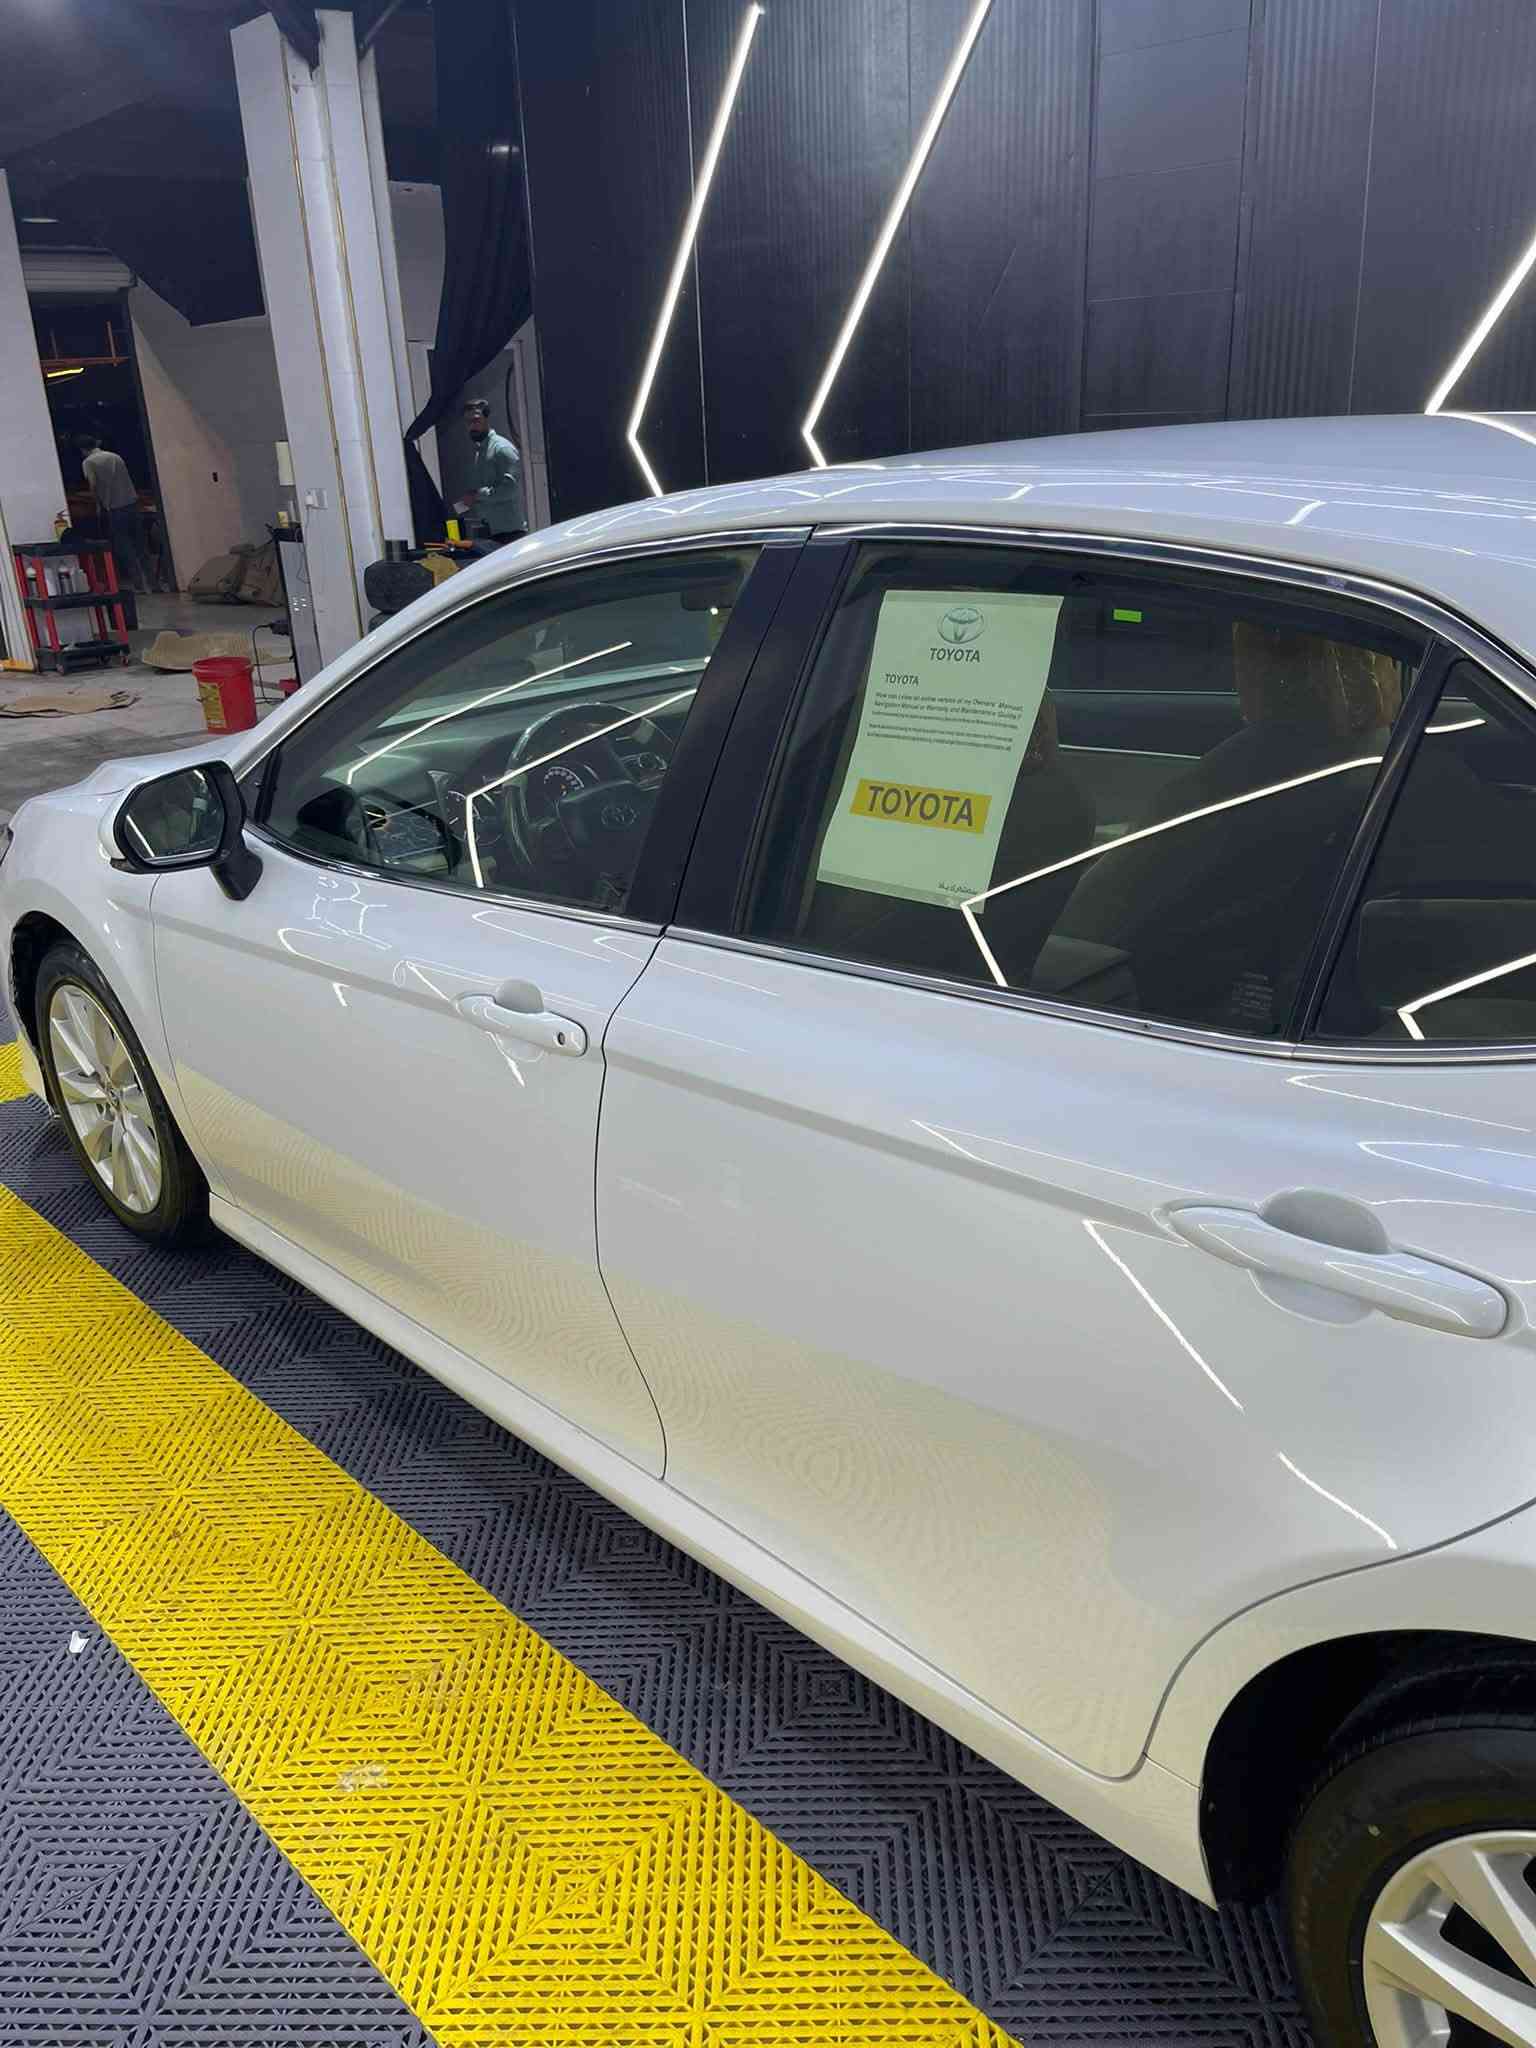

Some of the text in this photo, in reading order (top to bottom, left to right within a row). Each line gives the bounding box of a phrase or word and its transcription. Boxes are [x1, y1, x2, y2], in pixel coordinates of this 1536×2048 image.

[929, 647, 981, 663] TOYOTA
[885, 673, 919, 686] TOYOTA
[868, 785, 973, 827] TOYOTA
